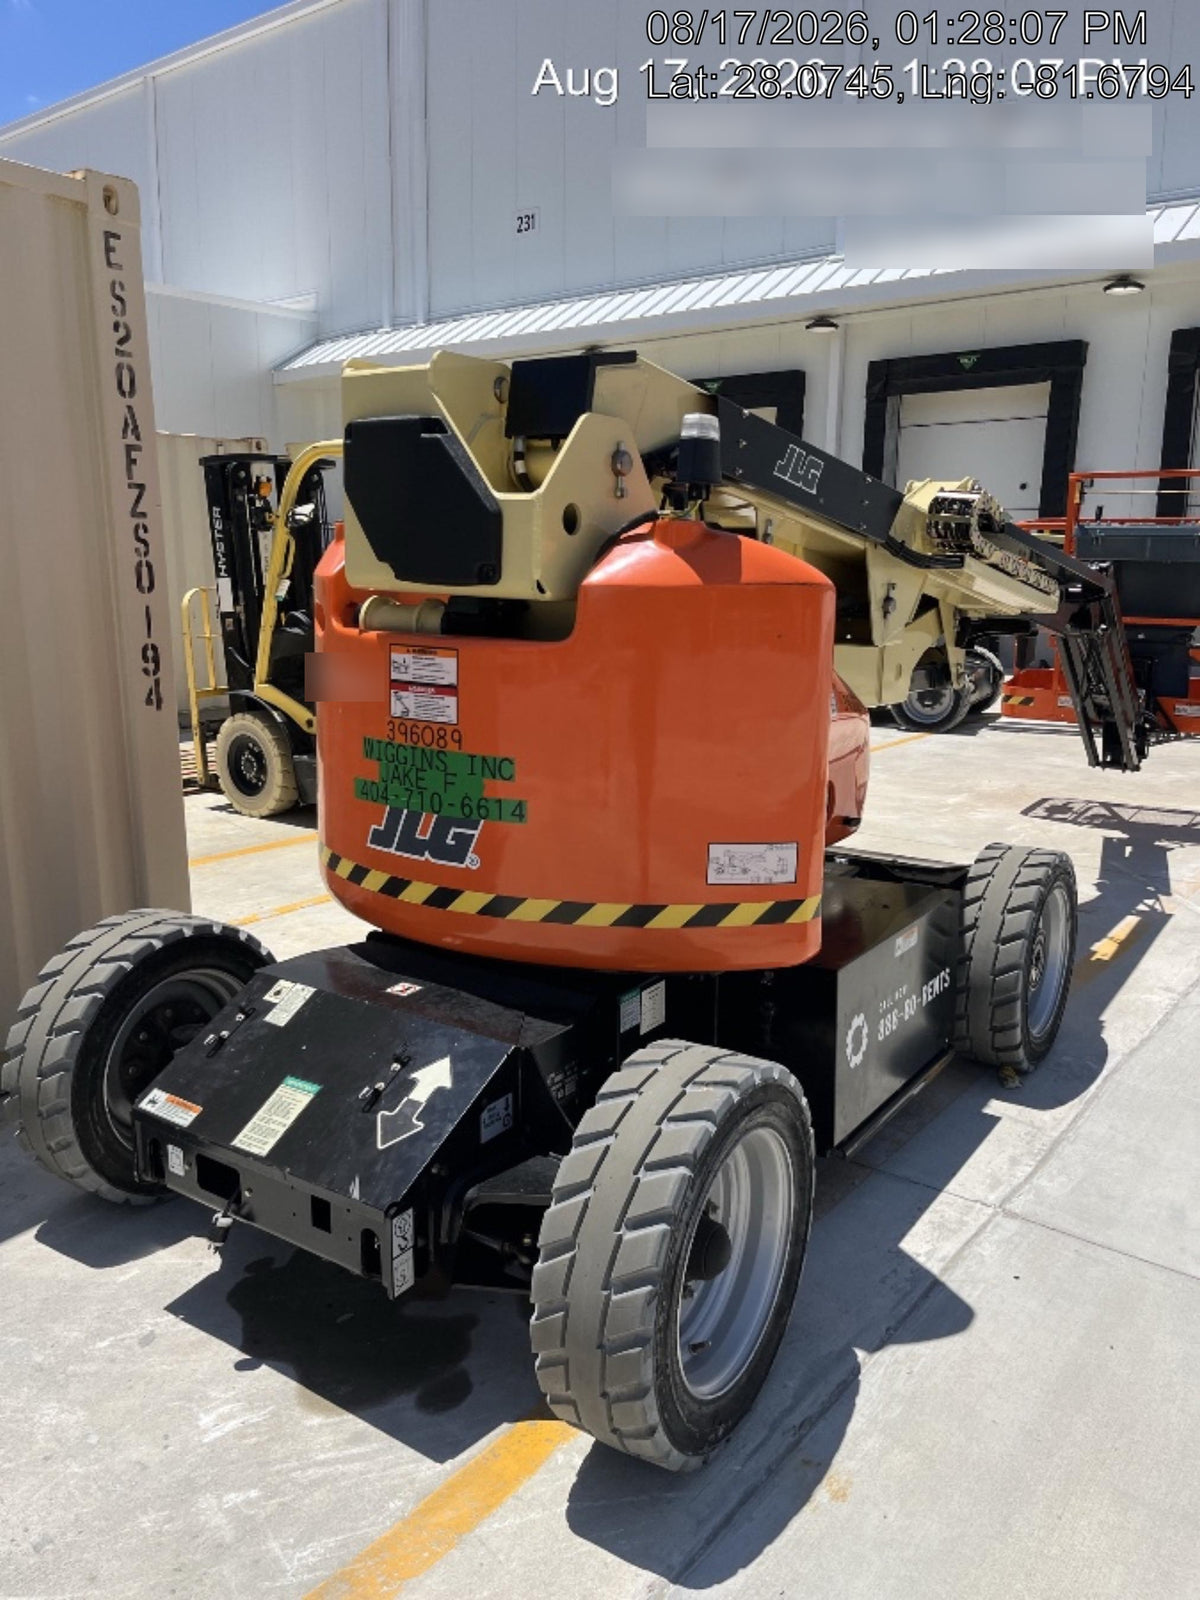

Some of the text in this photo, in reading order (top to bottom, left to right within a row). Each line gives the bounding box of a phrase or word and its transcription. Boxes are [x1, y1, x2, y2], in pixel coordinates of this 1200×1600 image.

[516, 214, 536, 234] 231
[773, 444, 824, 495] JLG
[212, 506, 228, 578] HYSTER
[387, 721, 463, 750] 396089
[363, 736, 516, 782] WIGGINS INC
[381, 763, 458, 794] JAKE F
[361, 781, 526, 823] 404-710-6614
[367, 804, 485, 869] JLG
